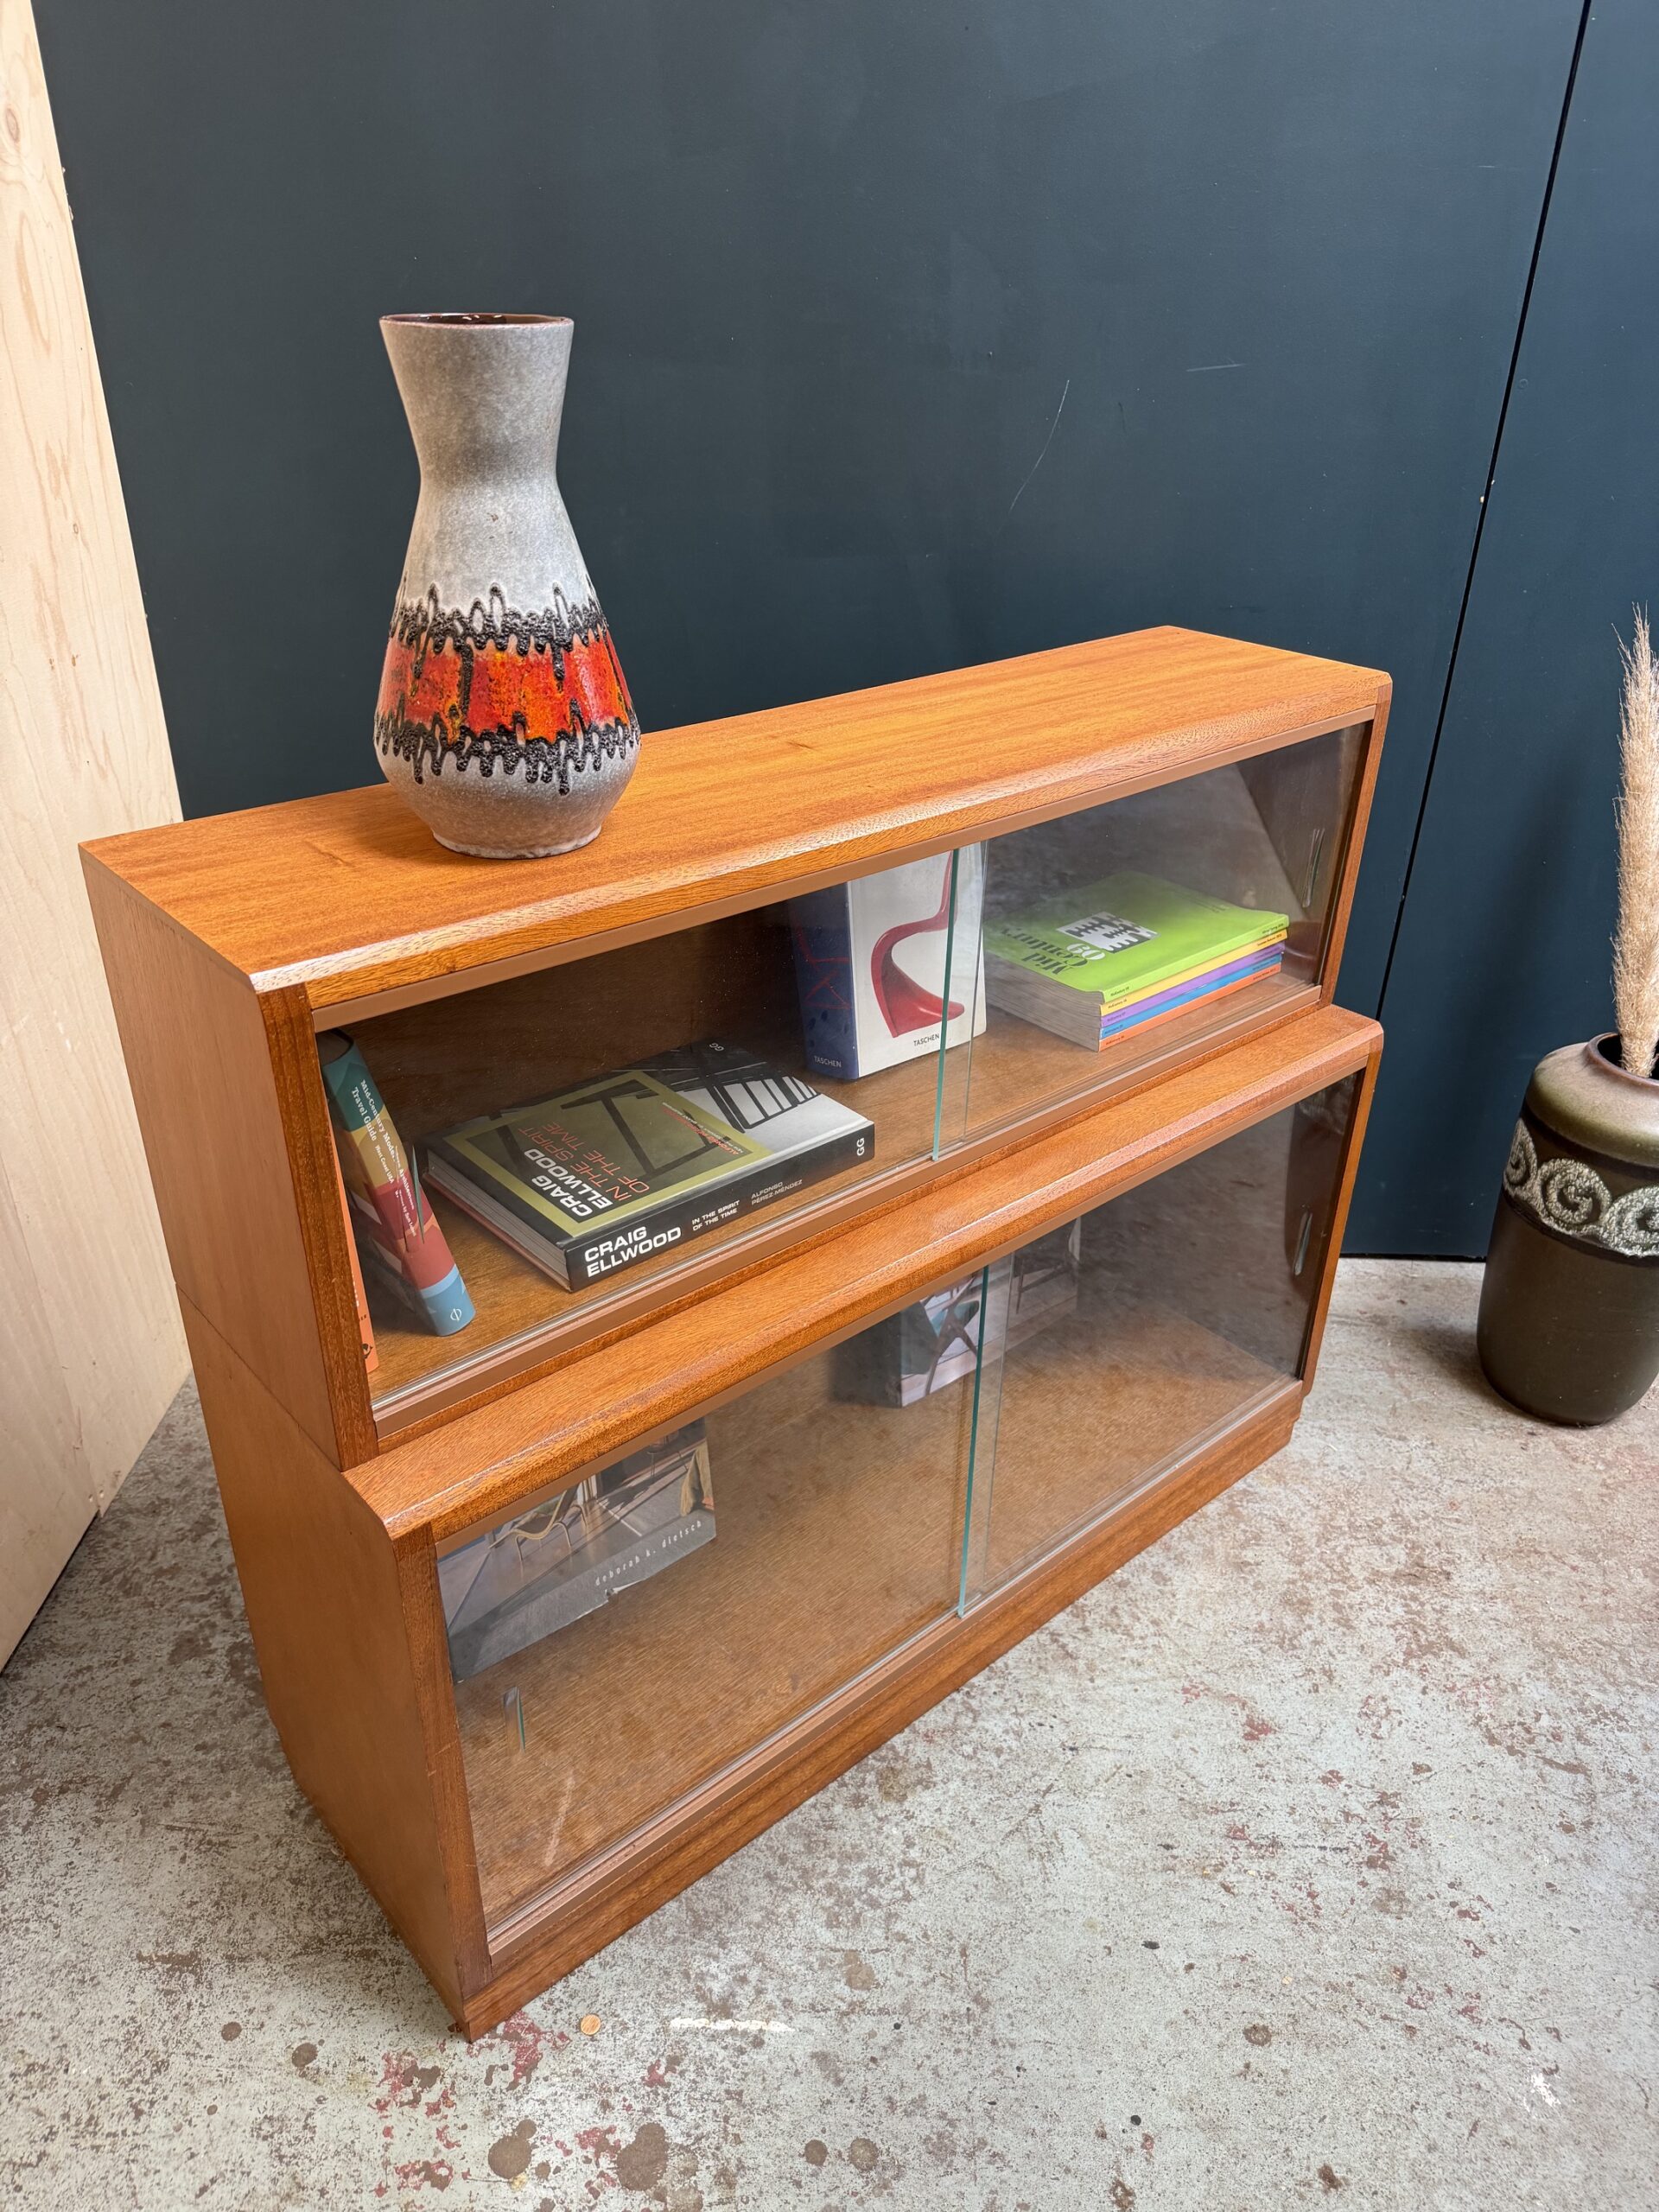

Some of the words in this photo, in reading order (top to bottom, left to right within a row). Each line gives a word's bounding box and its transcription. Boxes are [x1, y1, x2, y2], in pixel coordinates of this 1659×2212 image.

[1022, 952, 1070, 975] Mid
[709, 1042, 724, 1052] GG
[913, 1033, 940, 1046] TASCHEN
[814, 1055, 842, 1068] TASCHEN
[360, 1079, 385, 1134] Mid-Century
[352, 1086, 367, 1116] Travel
[364, 1116, 378, 1141] Guide
[386, 1171, 395, 1184] USA
[519, 1128, 574, 1161] SPIRIT
[542, 1122, 584, 1151] TIME
[856, 1137, 865, 1156] GG
[570, 1160, 608, 1188] THE
[582, 1150, 621, 1176] THE
[524, 1148, 613, 1209] ELLWOOD
[617, 1176, 650, 1193] OF
[752, 1181, 783, 1199] ALFONSO
[531, 1175, 593, 1217] CRAIG
[606, 1185, 632, 1201] IN
[692, 1223, 702, 1231] OF
[704, 1216, 718, 1225] THE
[720, 1207, 737, 1219] TIME
[702, 1211, 715, 1220] THE
[717, 1199, 740, 1214] SPIRIT
[584, 1226, 647, 1262] CRAIG
[586, 1226, 682, 1277] ELLWOOD
[595, 1555, 639, 1586] deborah
[662, 1520, 702, 1548] dietsch
